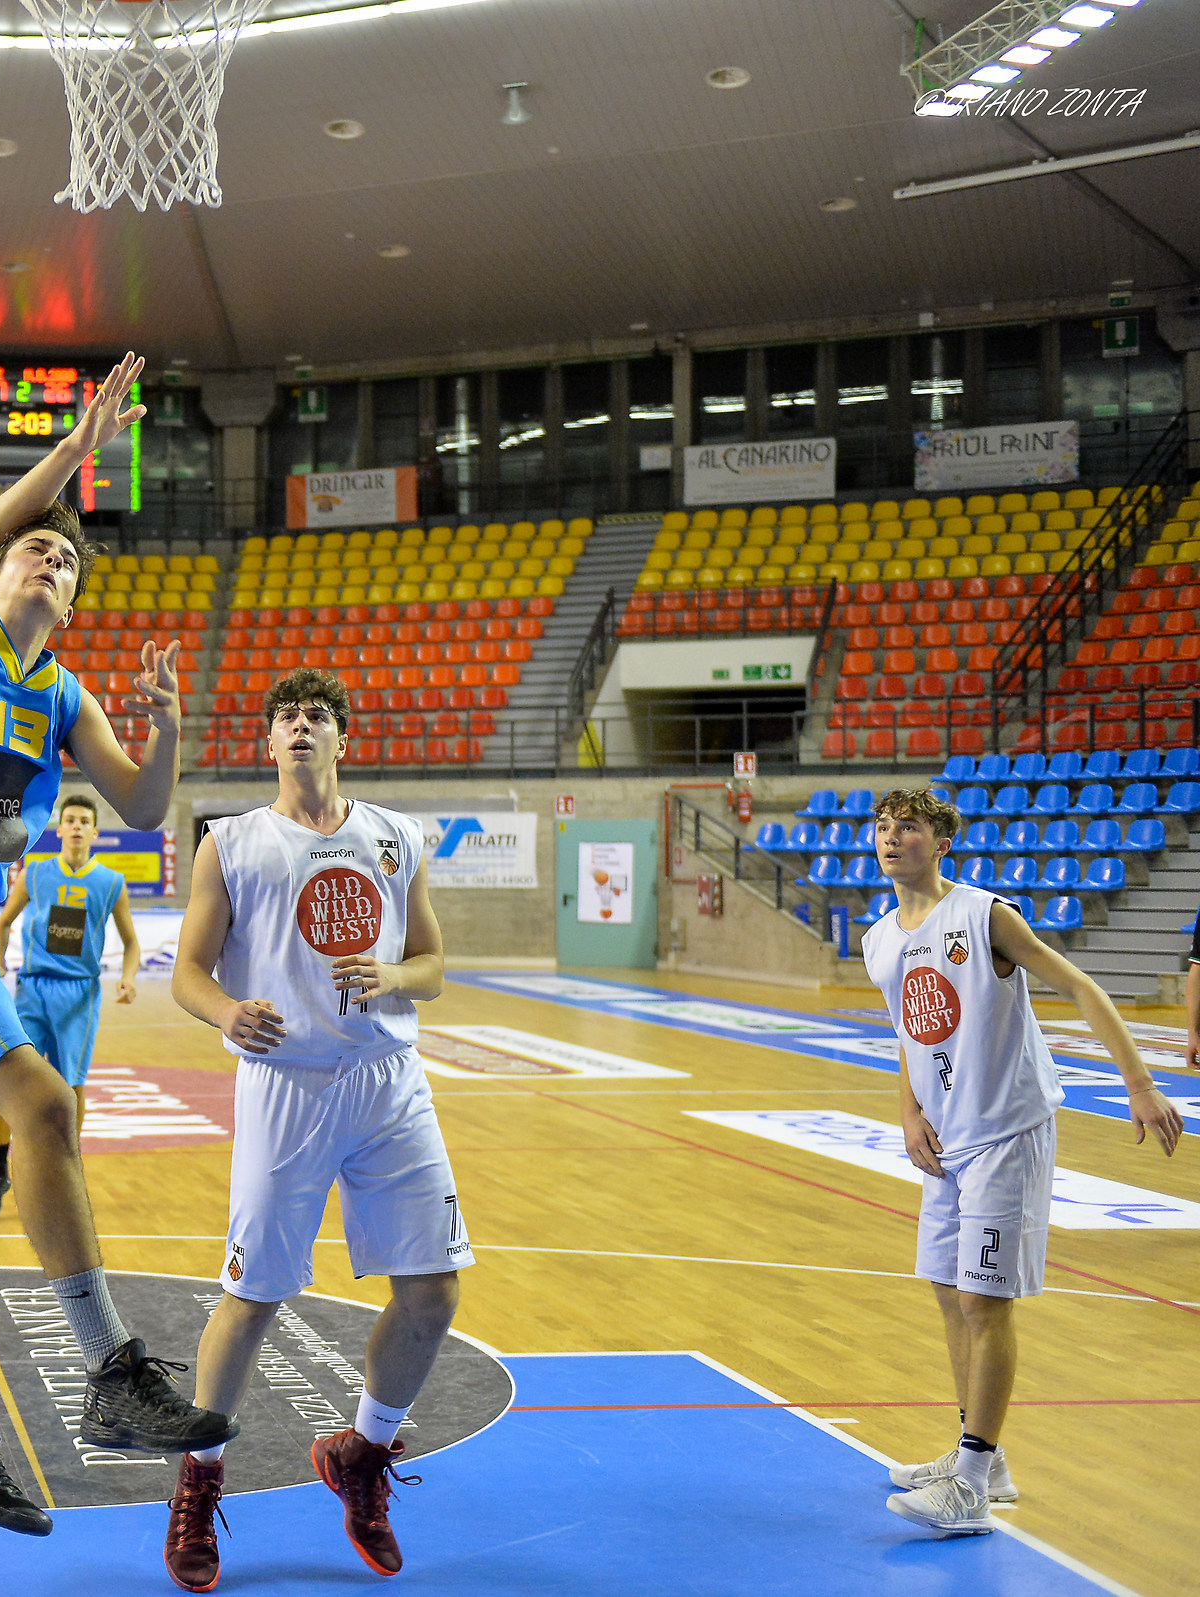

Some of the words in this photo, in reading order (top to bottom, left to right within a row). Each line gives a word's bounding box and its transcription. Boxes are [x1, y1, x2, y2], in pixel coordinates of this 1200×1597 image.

[465, 834, 517, 847] TILATTI
[162, 830, 177, 895] VOLTA
[310, 848, 355, 860] macron
[56, 884, 88, 908] 12
[314, 876, 362, 901] OLD
[309, 896, 372, 923] WILD
[309, 917, 378, 946] WEST
[944, 930, 967, 940] APU
[906, 973, 938, 997] OLD
[904, 990, 947, 1017] WILD
[906, 1008, 953, 1037] WEST
[932, 1051, 953, 1092] 2
[979, 1227, 1000, 1270] 2
[964, 1270, 1007, 1284] macron
